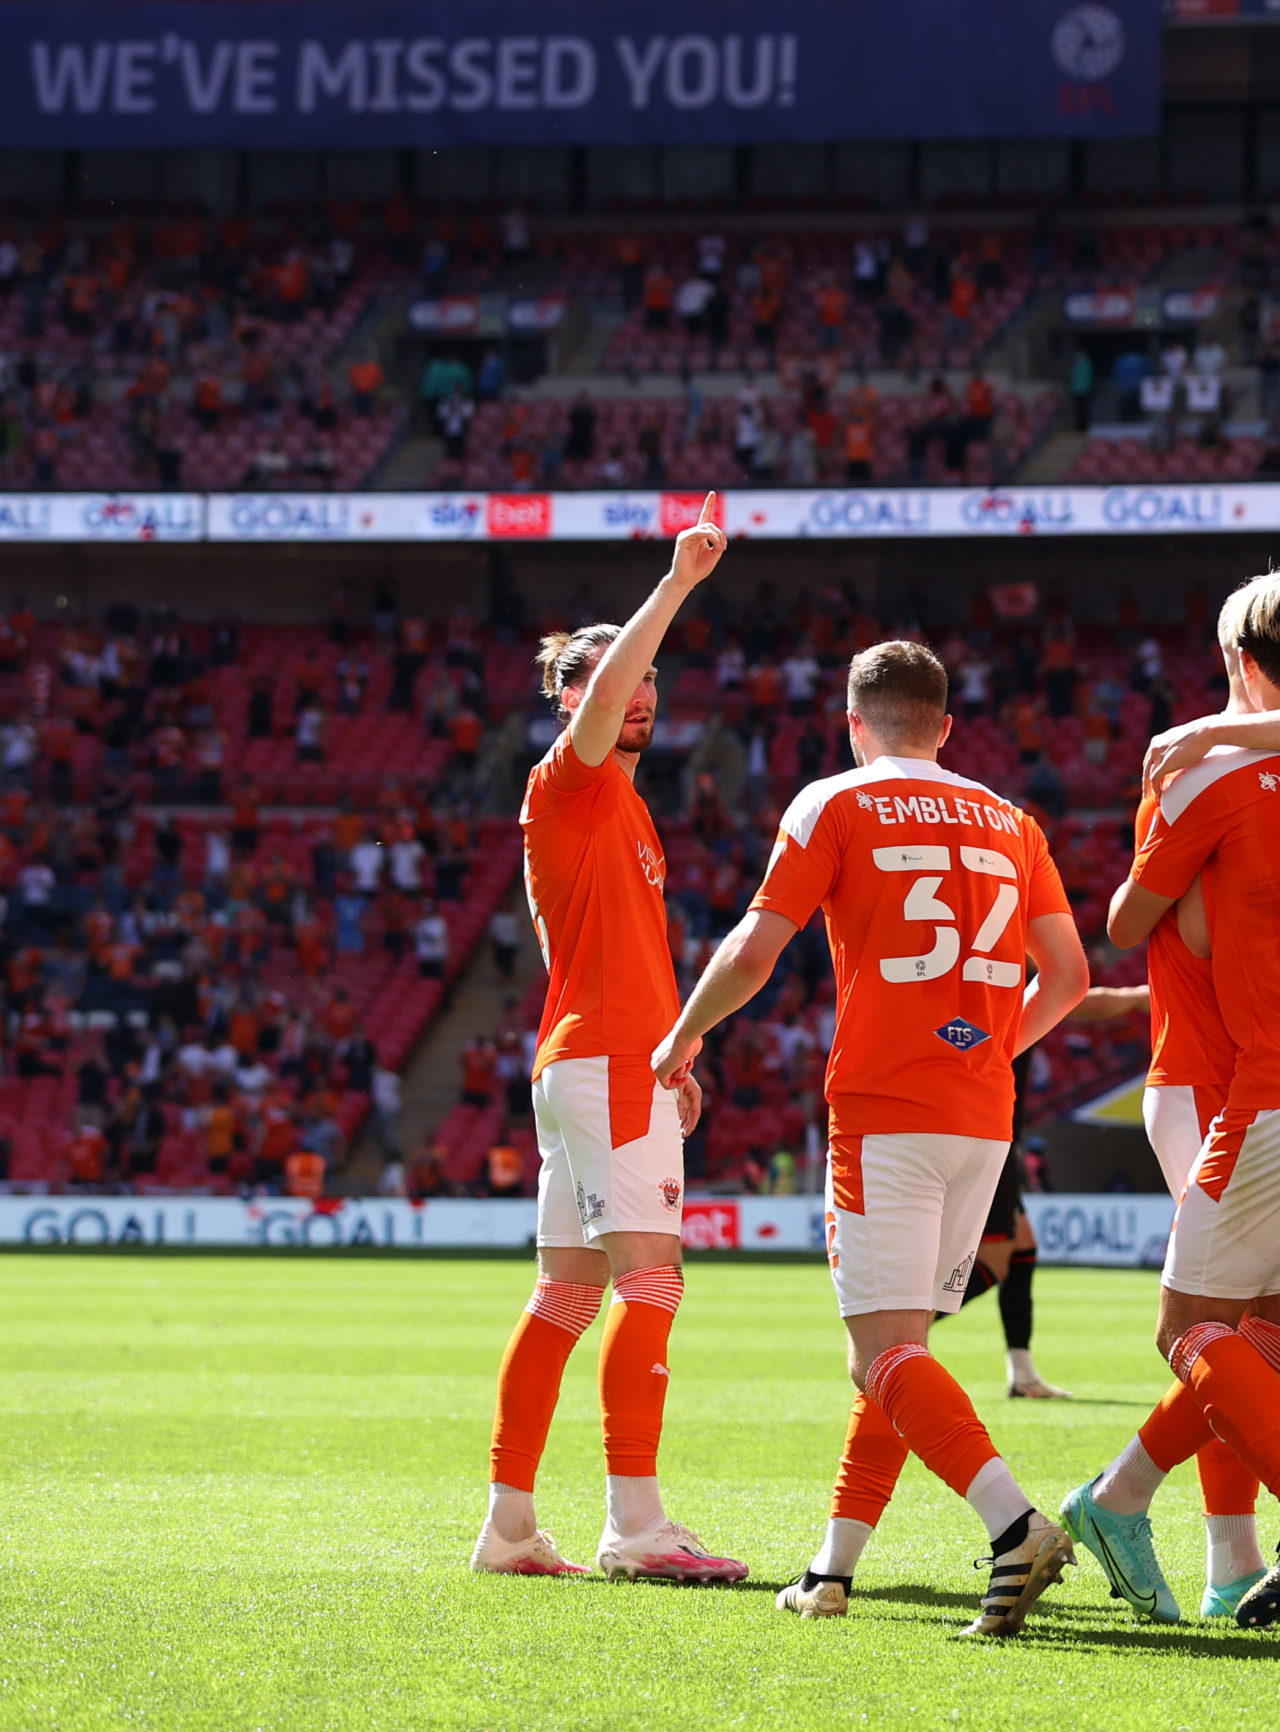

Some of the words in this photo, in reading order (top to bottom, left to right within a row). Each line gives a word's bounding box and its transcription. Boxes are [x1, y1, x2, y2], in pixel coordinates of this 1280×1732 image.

[32, 34, 280, 112] WE'VE
[297, 37, 597, 112] MISSED
[615, 34, 798, 108] YOU!
[231, 500, 348, 529] GOAL!
[811, 495, 930, 528] GOAL!
[1102, 491, 1221, 524] GOAL!
[875, 796, 1020, 837] EMBLETON
[872, 845, 1022, 988] 32
[947, 1026, 973, 1042] FTS
[24, 1208, 195, 1245] GOAL!
[260, 1209, 424, 1245] GOAL!
[1038, 1207, 1138, 1253] GOAL!
